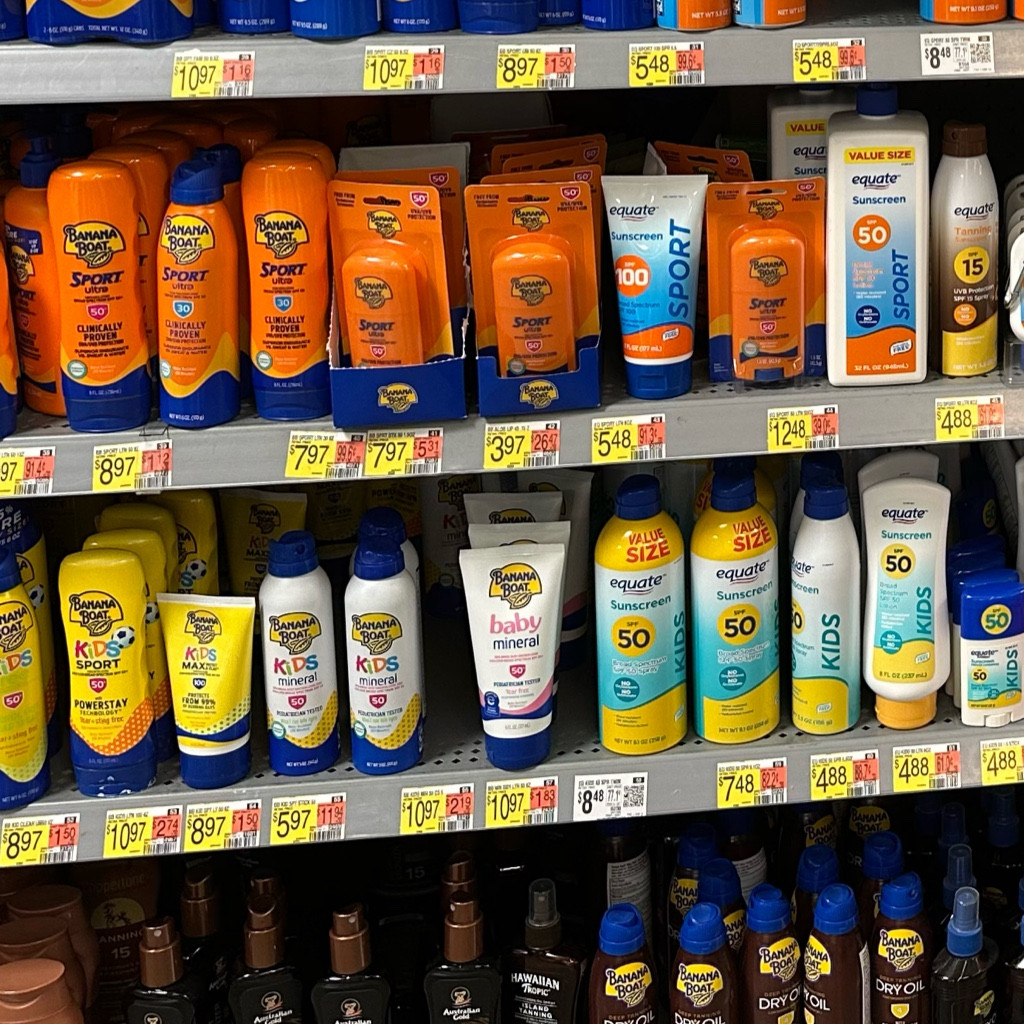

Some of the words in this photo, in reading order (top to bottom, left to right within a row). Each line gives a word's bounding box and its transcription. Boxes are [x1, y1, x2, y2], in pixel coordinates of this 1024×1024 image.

[849, 151, 885, 160] VALUE
[888, 151, 911, 159] SIZE
[853, 173, 901, 186] equate
[610, 205, 659, 218] equate
[612, 232, 663, 241] Sunscreen
[858, 226, 887, 243] 50
[954, 226, 991, 236] Tanning
[668, 219, 691, 318] SPORT
[963, 259, 983, 276] 15
[77, 322, 122, 332] CLINICALLY
[84, 331, 117, 340] PROVEN
[611, 596, 671, 611] Sunscreen
[490, 614, 542, 635] baby
[493, 636, 539, 650] mineral
[821, 613, 840, 671] KIDS
[76, 659, 120, 670] SPORT
[278, 673, 317, 687] mineral
[75, 698, 128, 710] POWERSTAY
[876, 982, 901, 995] DRY
[904, 980, 925, 992] OIL
